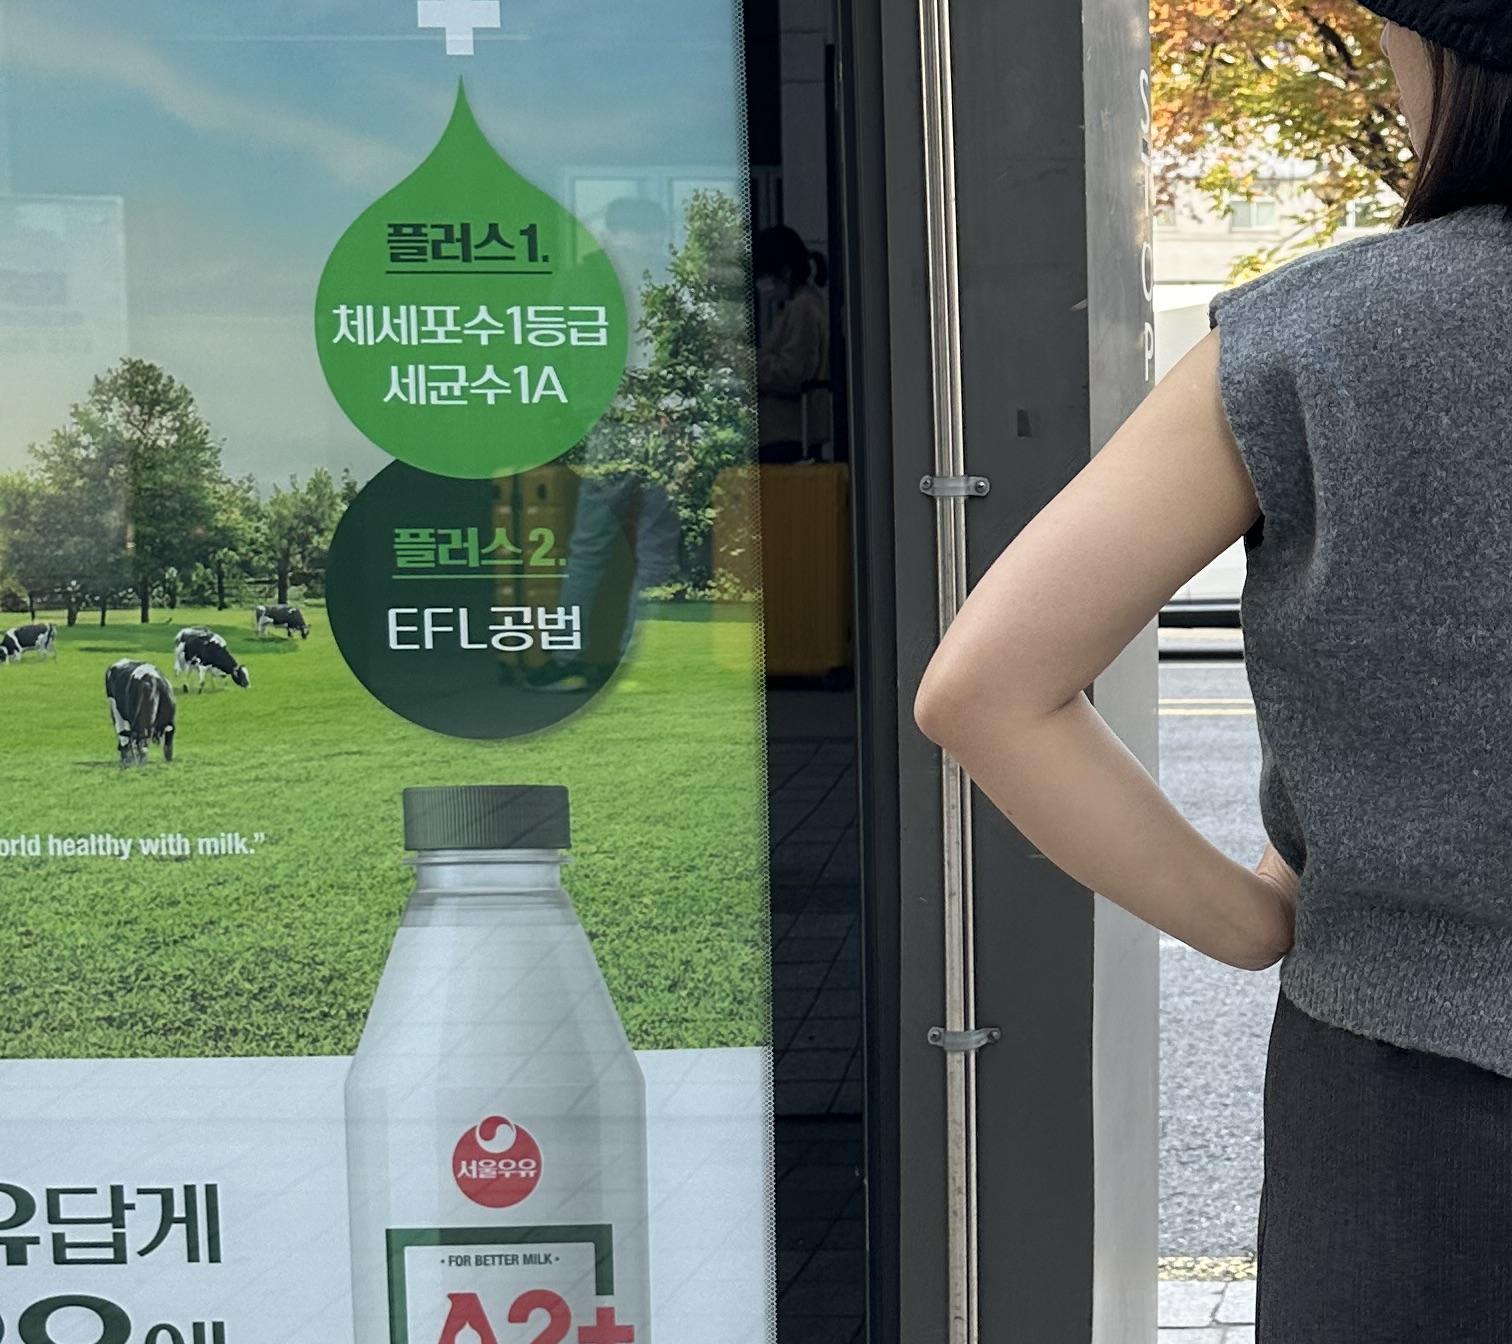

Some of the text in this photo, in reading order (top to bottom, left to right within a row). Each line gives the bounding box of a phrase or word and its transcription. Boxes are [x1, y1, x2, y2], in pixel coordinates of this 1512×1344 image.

[331, 303, 609, 347] 체세포수1등급
[383, 364, 569, 406] 세균수1A
[387, 604, 583, 653] EFL공법
[48, 833, 132, 861] healthy
[139, 833, 190, 856] with
[457, 1158, 538, 1180] 서울우유
[448, 1253, 553, 1267] FOR BETTER MILK
